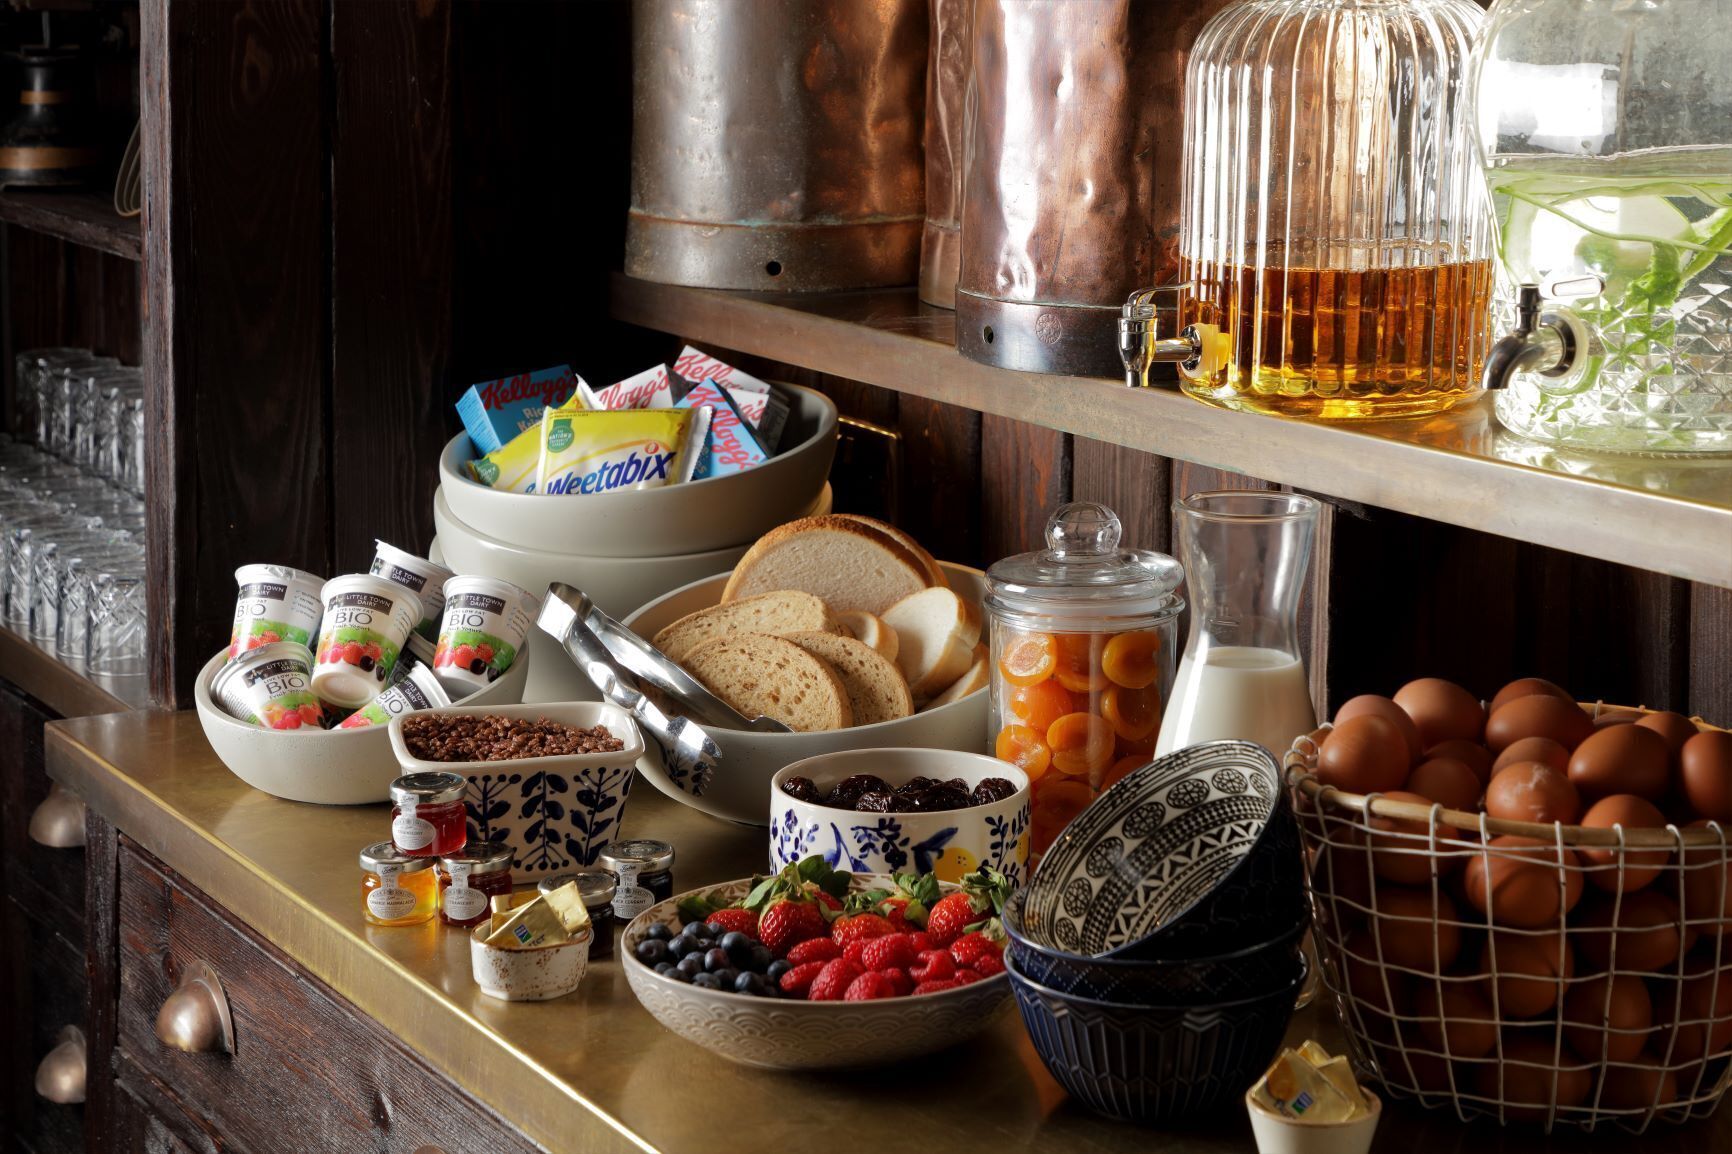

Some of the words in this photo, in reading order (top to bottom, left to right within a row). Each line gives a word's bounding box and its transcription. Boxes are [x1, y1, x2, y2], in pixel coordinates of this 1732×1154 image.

[599, 370, 669, 410] llogg's
[547, 442, 677, 495] Weetabix
[392, 573, 410, 585] DAIRY
[404, 572, 424, 585] TOWN
[263, 585, 284, 593] TOWN
[369, 596, 391, 607] TOWN
[470, 600, 489, 608] DAIRY
[482, 597, 503, 607] TOWN
[335, 611, 373, 625] BIO
[449, 613, 484, 627] BIO
[266, 661, 288, 670] LITTLE
[265, 676, 304, 695] BIO
[404, 679, 417, 693] LITTLE
[379, 690, 404, 714] BIO
[404, 689, 418, 703] DAIRY
